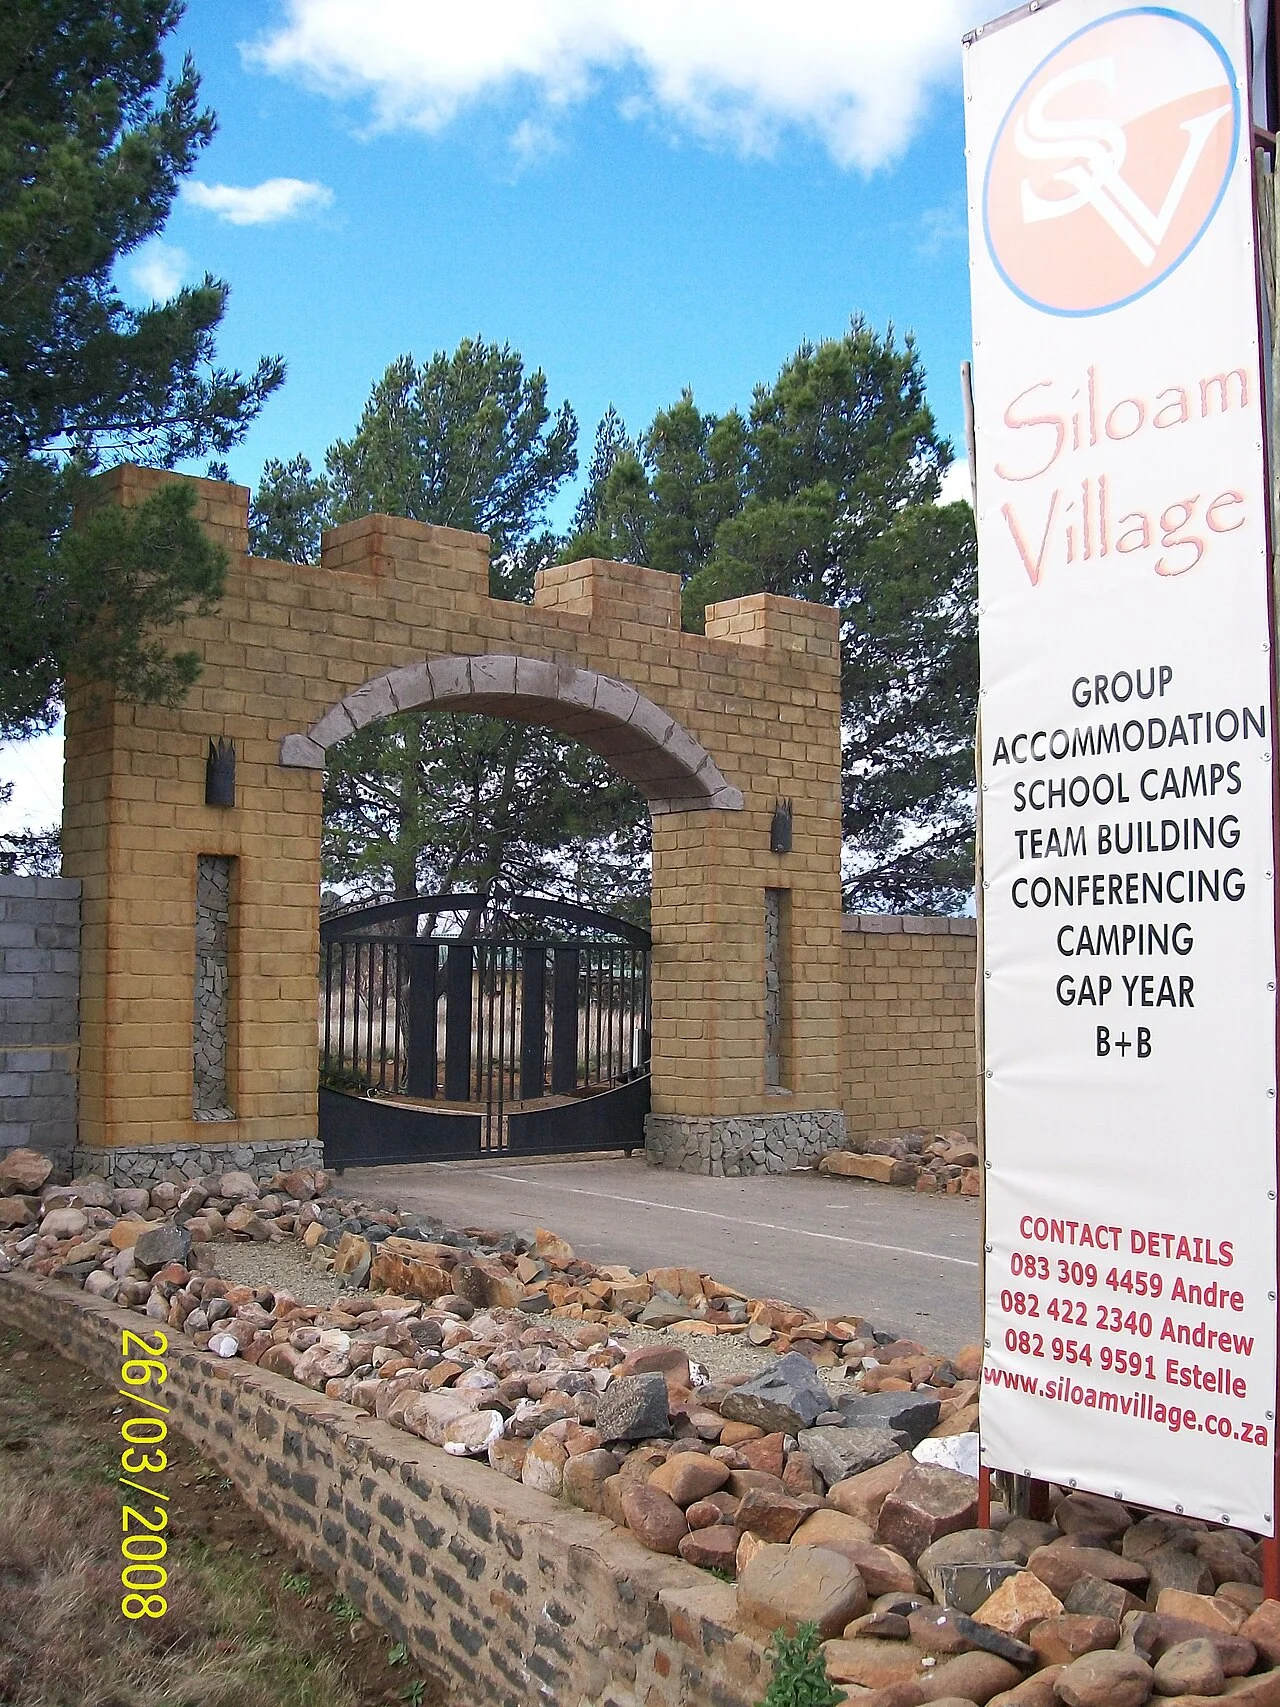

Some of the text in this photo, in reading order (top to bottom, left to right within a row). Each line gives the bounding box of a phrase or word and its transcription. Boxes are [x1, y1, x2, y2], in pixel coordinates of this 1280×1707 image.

[994, 364, 1249, 482] Siloam
[1001, 474, 1246, 587] Village
[1072, 665, 1173, 708] GROUP
[992, 705, 1266, 766] ACCOMMODATION
[1014, 760, 1242, 812] SCHOOL CAMPS
[1015, 814, 1241, 859] TEAM BUILDING
[1011, 868, 1246, 908] CONFERENCING
[1057, 923, 1194, 956] CAMPING
[1056, 975, 1195, 1008] GAP YEAR
[1096, 1025, 1152, 1059] B+B
[1020, 1215, 1234, 1267] CONTACT DETAILS
[1010, 1252, 1244, 1312] 083 309 4459 Andre
[1000, 1289, 1254, 1357] 082 422 2340 Andrew
[1005, 1328, 1247, 1399] 082 954 9591 Estelle
[984, 1366, 1269, 1447] www.siloamvillage.co.za
